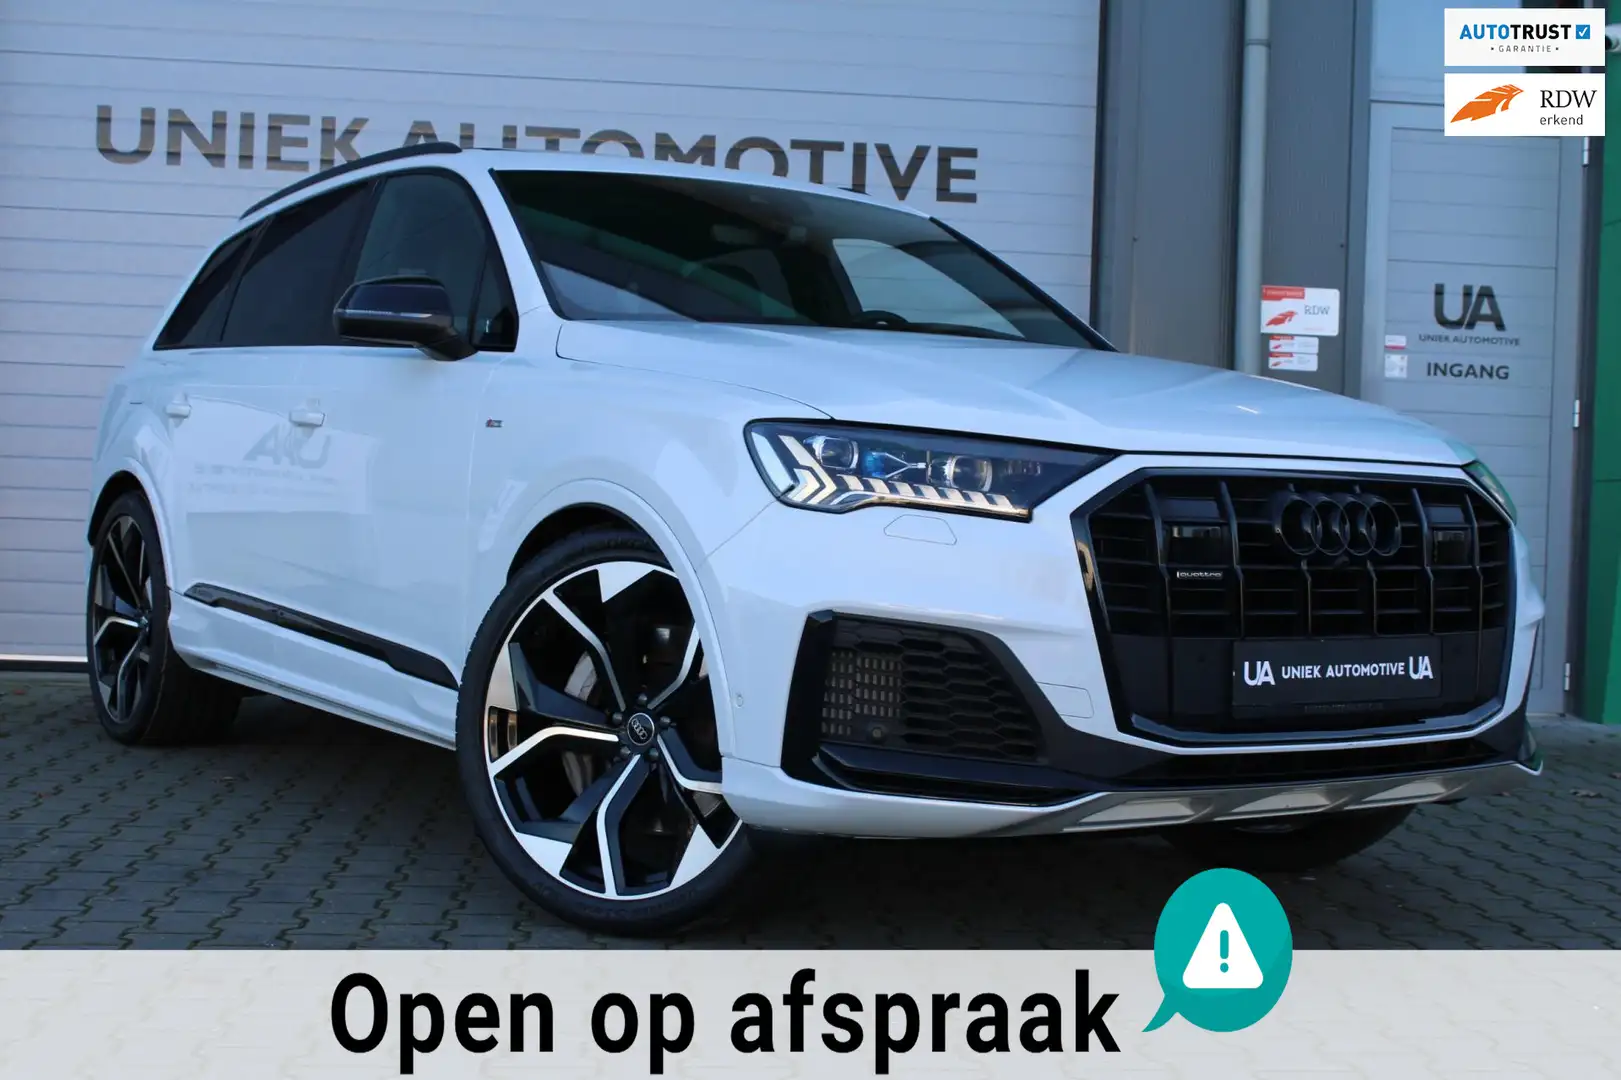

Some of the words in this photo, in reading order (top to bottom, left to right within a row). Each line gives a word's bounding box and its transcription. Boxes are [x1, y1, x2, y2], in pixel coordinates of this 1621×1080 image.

[95, 104, 370, 171] UNIEK
[1433, 283, 1507, 332] UA
[1418, 333, 1450, 343] UNIEK
[1452, 336, 1521, 346] AUTOMOTIVE
[1427, 362, 1510, 380] INGANG
[1243, 660, 1276, 686] UA
[1281, 664, 1322, 679] UNIEK
[1325, 661, 1406, 678] AUTOMOTIVE
[1408, 655, 1434, 680] UA
